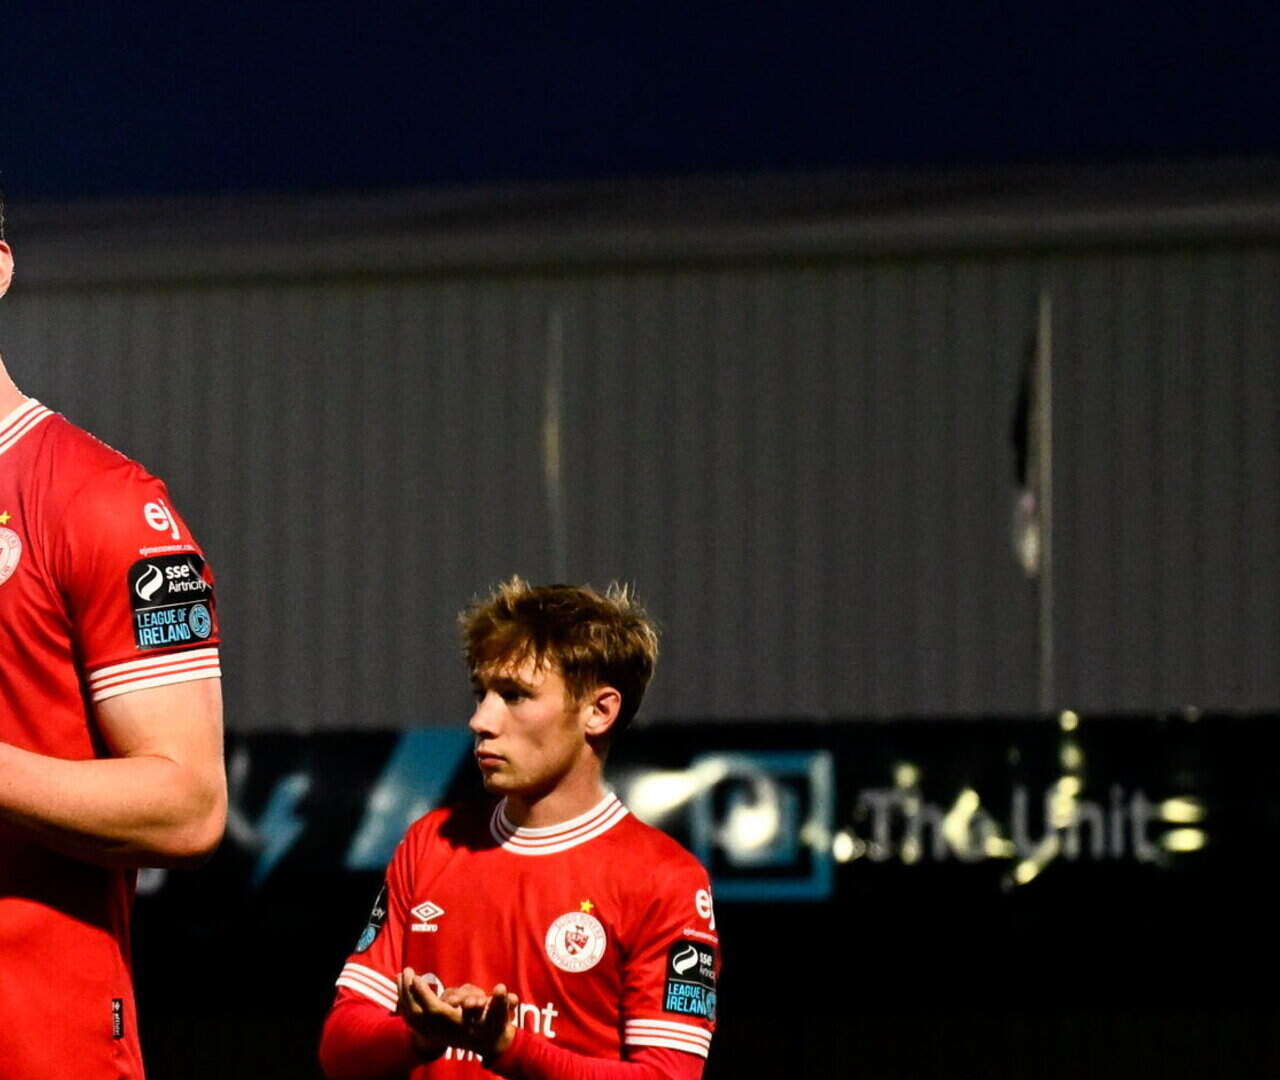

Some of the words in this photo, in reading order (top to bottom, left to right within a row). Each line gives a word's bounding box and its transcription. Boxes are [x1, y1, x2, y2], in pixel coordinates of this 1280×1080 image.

[143, 498, 181, 541] ej
[165, 564, 190, 580] sse
[137, 609, 177, 628] LEAGUE
[178, 608, 187, 623] OF
[139, 623, 191, 645] IRELAND
[669, 983, 701, 1002] LEAGUE
